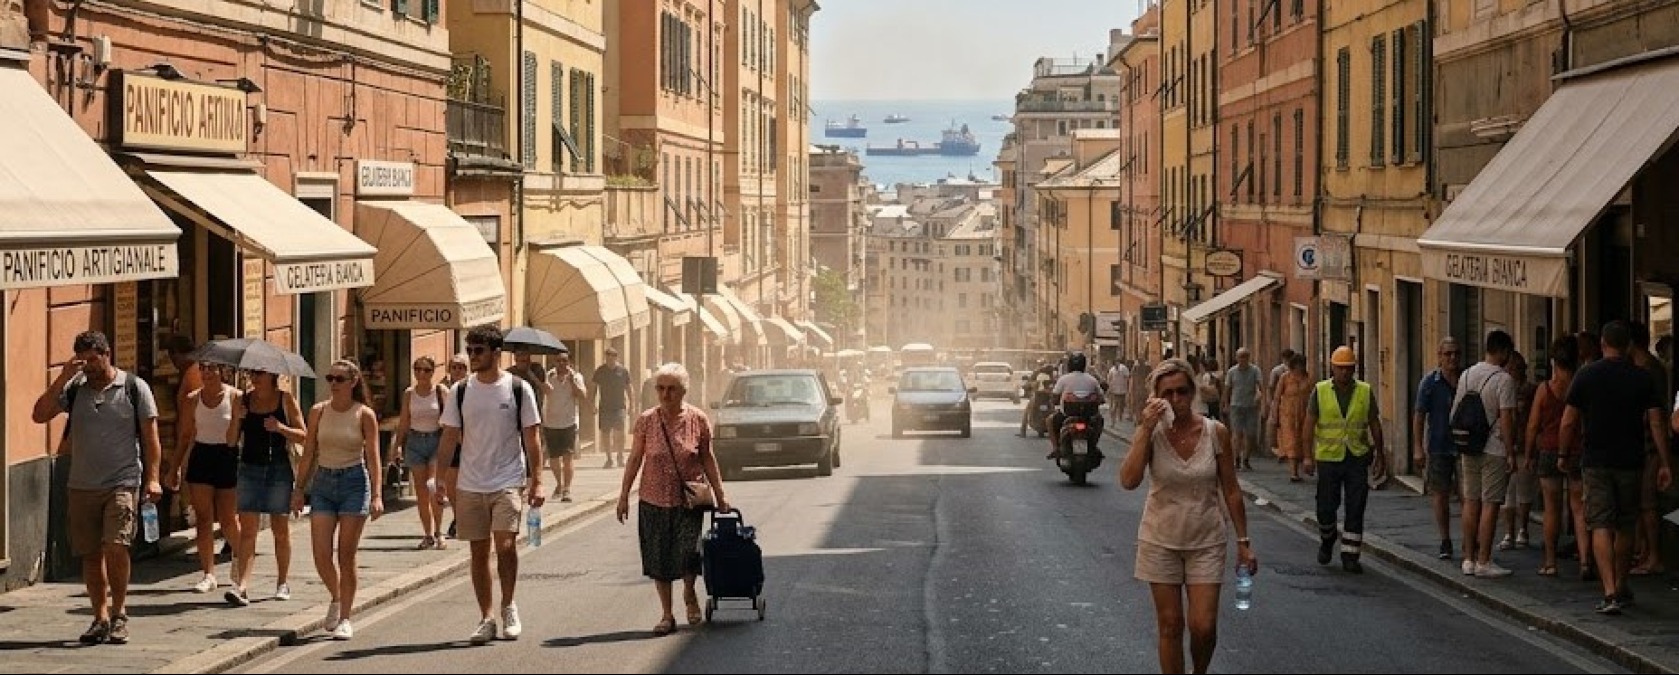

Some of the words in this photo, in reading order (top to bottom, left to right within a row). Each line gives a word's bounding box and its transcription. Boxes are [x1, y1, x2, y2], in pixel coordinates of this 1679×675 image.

[126, 83, 194, 138] PANIFICIO
[3, 250, 75, 282] PANIFICIO
[82, 245, 166, 278] ARTIGIANALE
[370, 308, 452, 323] PANIFICIO
